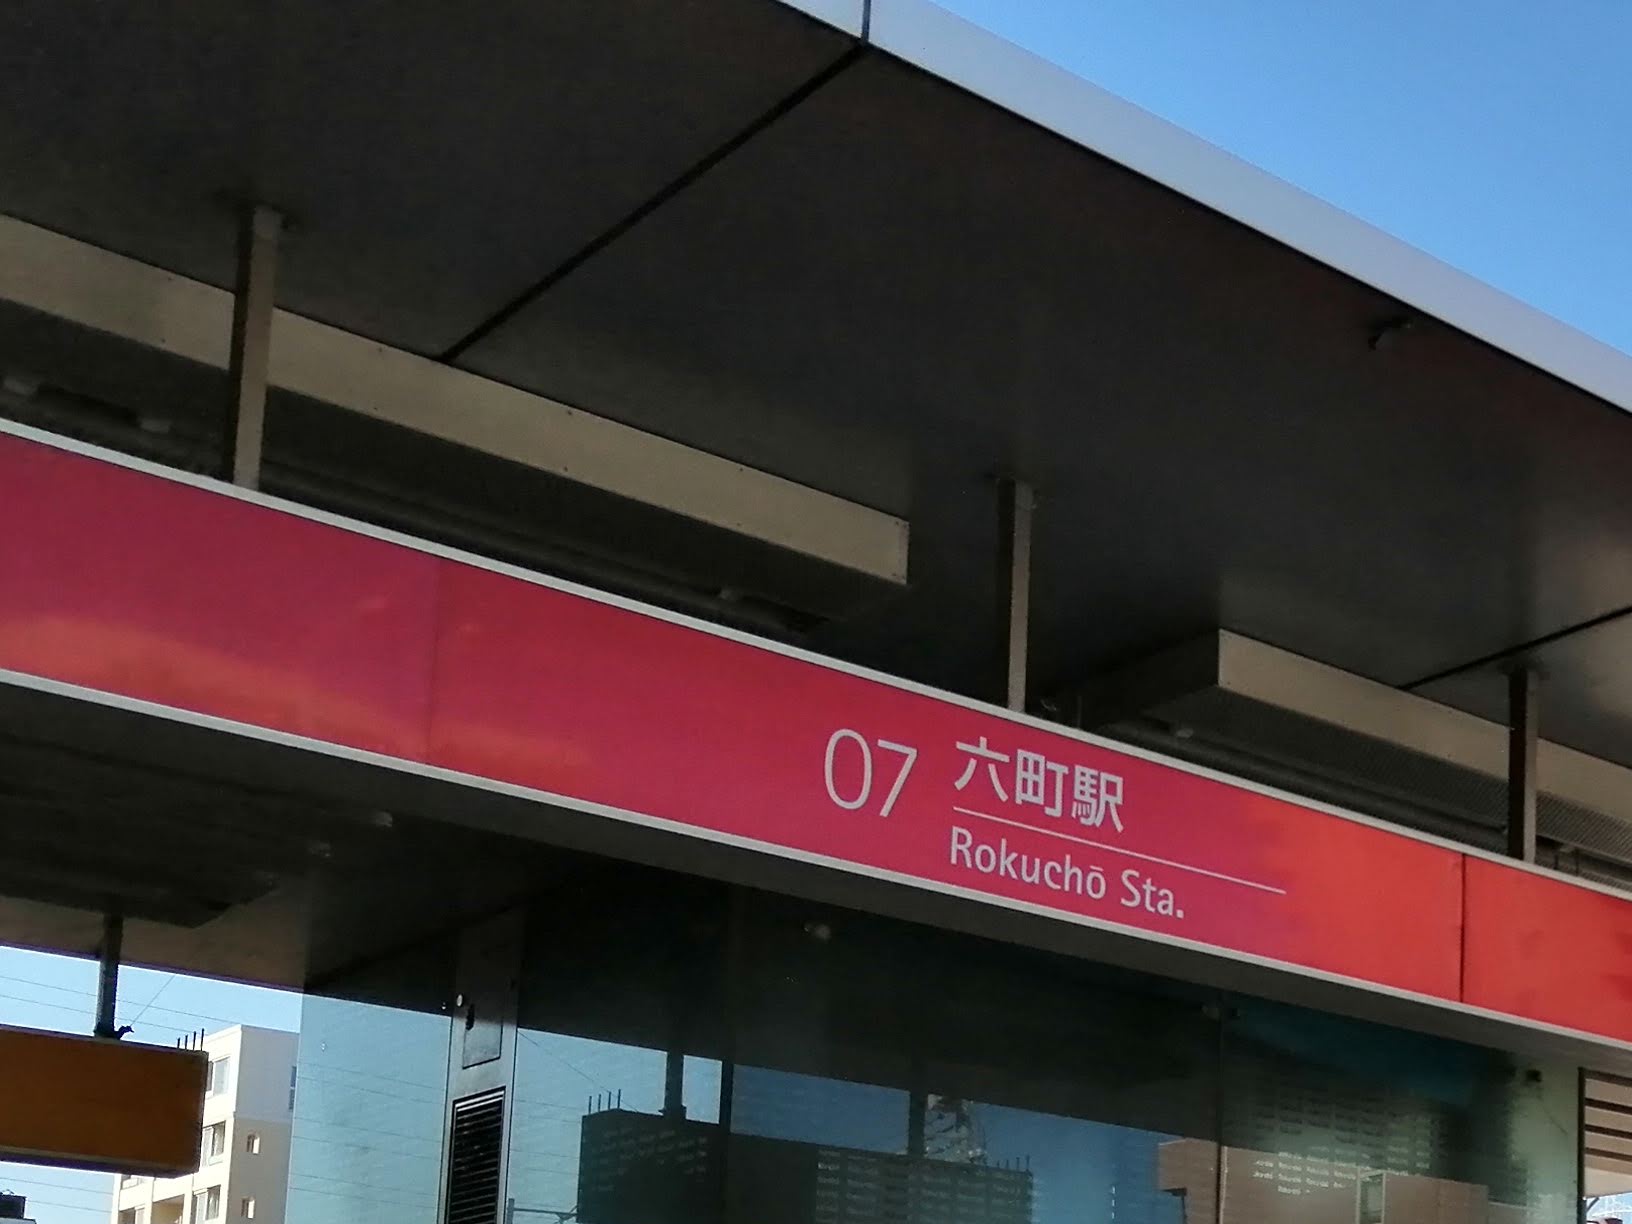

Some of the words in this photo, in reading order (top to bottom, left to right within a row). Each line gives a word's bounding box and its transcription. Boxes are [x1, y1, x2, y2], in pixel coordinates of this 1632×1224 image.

[824, 728, 918, 818] 07
[953, 736, 1125, 833] 六町駅
[949, 825, 1107, 900] Rokuchō
[1120, 868, 1185, 919] Sta.
